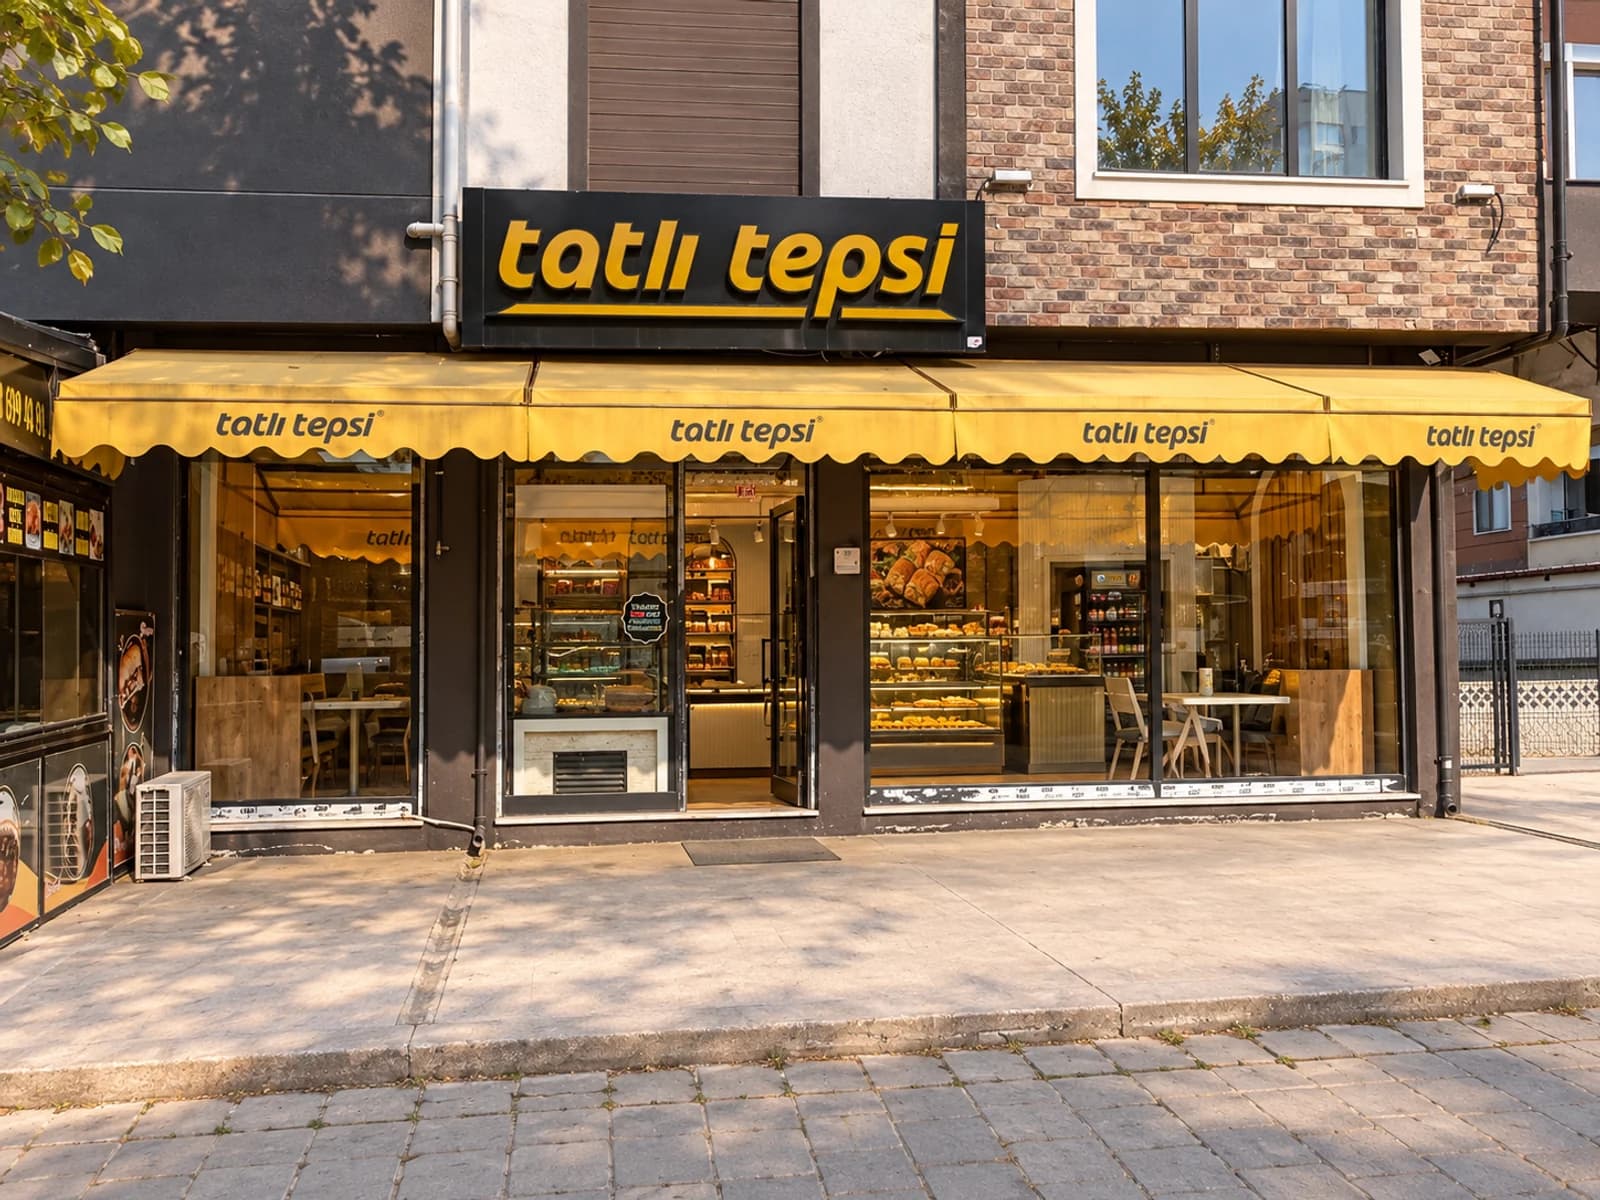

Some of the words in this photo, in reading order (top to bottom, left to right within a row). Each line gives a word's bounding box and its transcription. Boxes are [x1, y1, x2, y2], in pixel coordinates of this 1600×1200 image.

[498, 219, 699, 291] tatlı
[727, 222, 960, 319] tepsi
[216, 412, 287, 437] tatlı
[670, 419, 735, 442] tatlı
[1083, 422, 1138, 443] tatlı
[1426, 425, 1474, 447] tatlı
